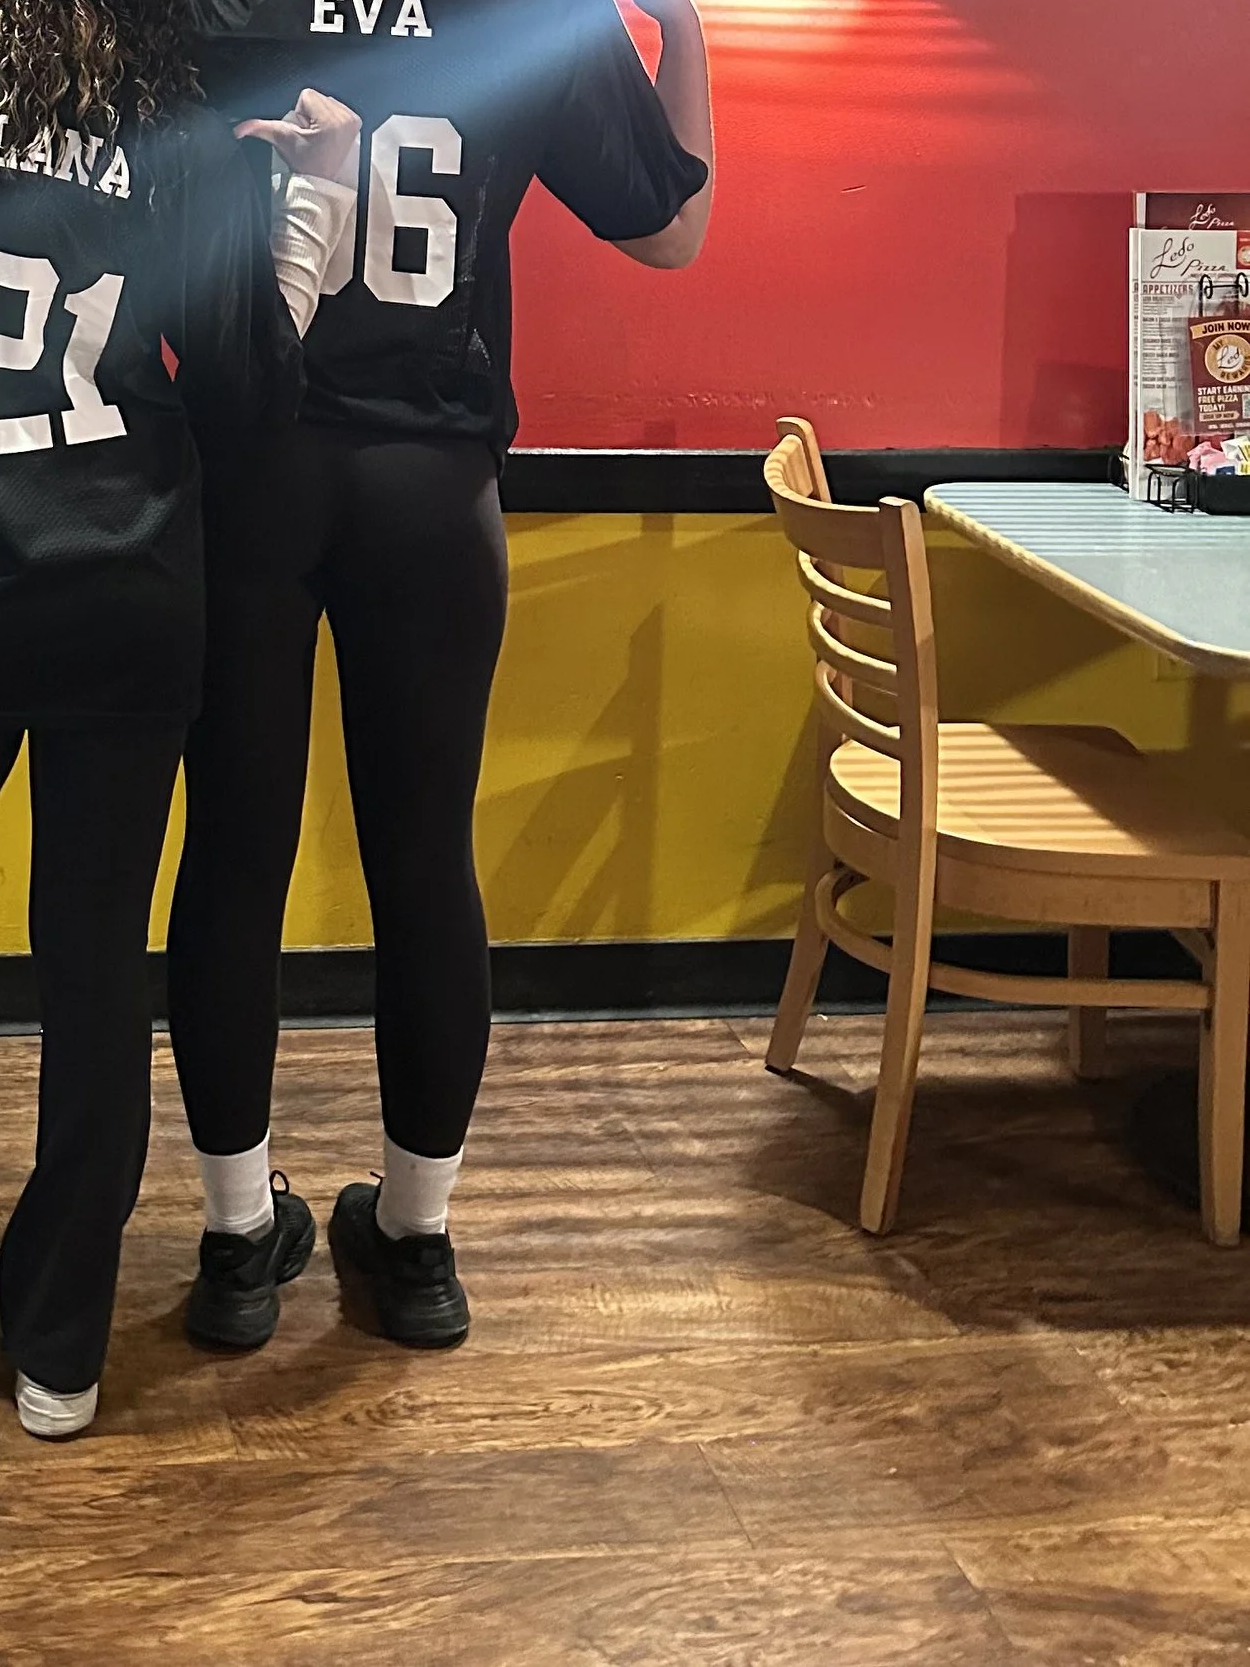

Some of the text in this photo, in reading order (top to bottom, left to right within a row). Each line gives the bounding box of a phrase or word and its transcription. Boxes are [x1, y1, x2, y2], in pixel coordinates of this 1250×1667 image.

[1150, 236, 1195, 280] Ledo
[1180, 259, 1228, 277] Pizza
[1142, 283, 1194, 295] APPETIZERS
[1202, 322, 1225, 334] JOIN
[1198, 386, 1222, 395] START
